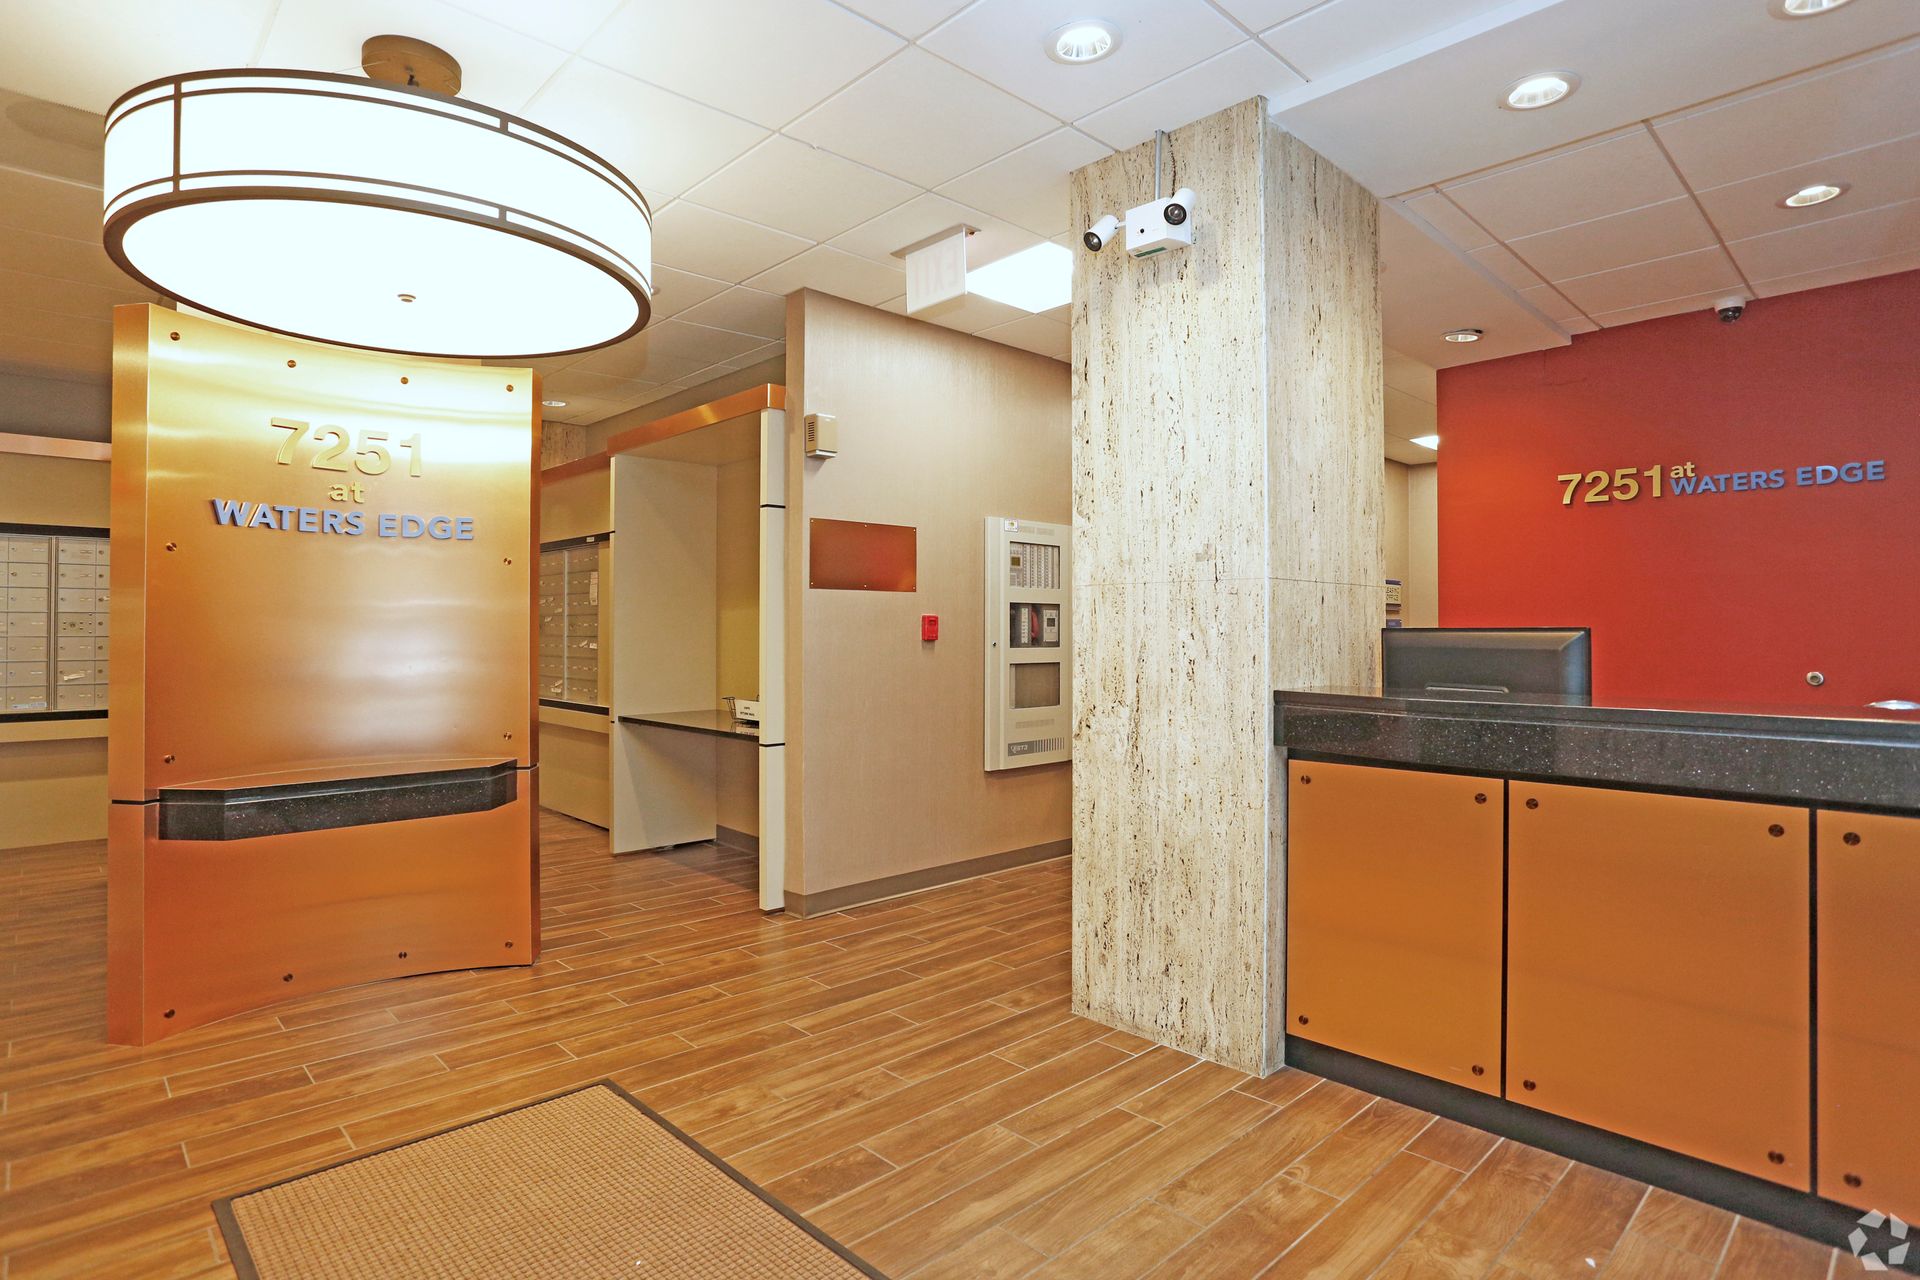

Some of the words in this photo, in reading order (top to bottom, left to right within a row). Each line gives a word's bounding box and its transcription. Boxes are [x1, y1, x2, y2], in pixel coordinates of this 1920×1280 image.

[271, 416, 423, 478] 7251
[328, 479, 365, 504] at
[1557, 464, 1662, 505] 7251
[1670, 461, 1695, 479] at
[1670, 468, 1785, 496] WATERS
[1796, 460, 1886, 486] EDGE
[211, 497, 365, 536] WATERS
[379, 513, 475, 540] EDGE
